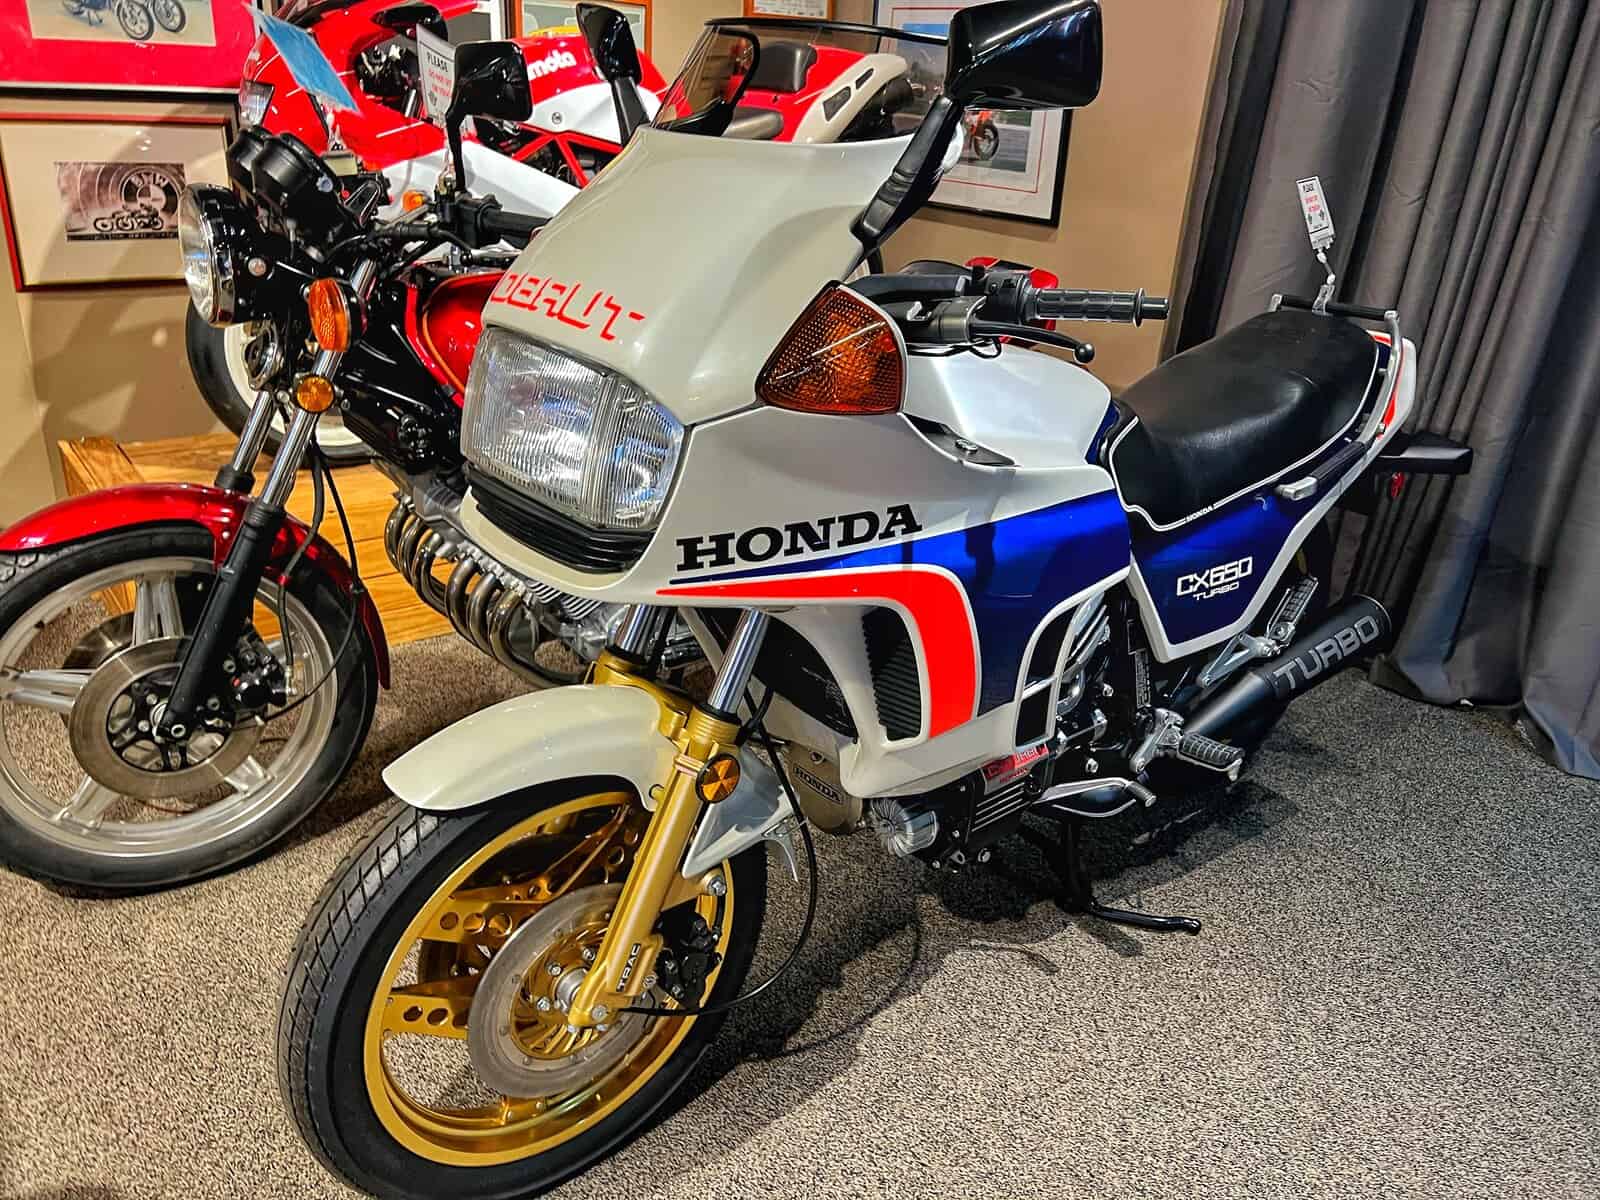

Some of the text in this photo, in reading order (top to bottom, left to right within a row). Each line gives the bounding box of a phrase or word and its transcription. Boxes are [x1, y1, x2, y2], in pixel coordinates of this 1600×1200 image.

[1185, 505, 1214, 522] HONDA
[676, 503, 923, 572] HONDA
[1176, 556, 1253, 597] CX650
[1192, 581, 1240, 601] TURBO
[1272, 615, 1380, 690] TURBO
[793, 767, 842, 802] HONDA
[616, 943, 641, 991] TRAC
